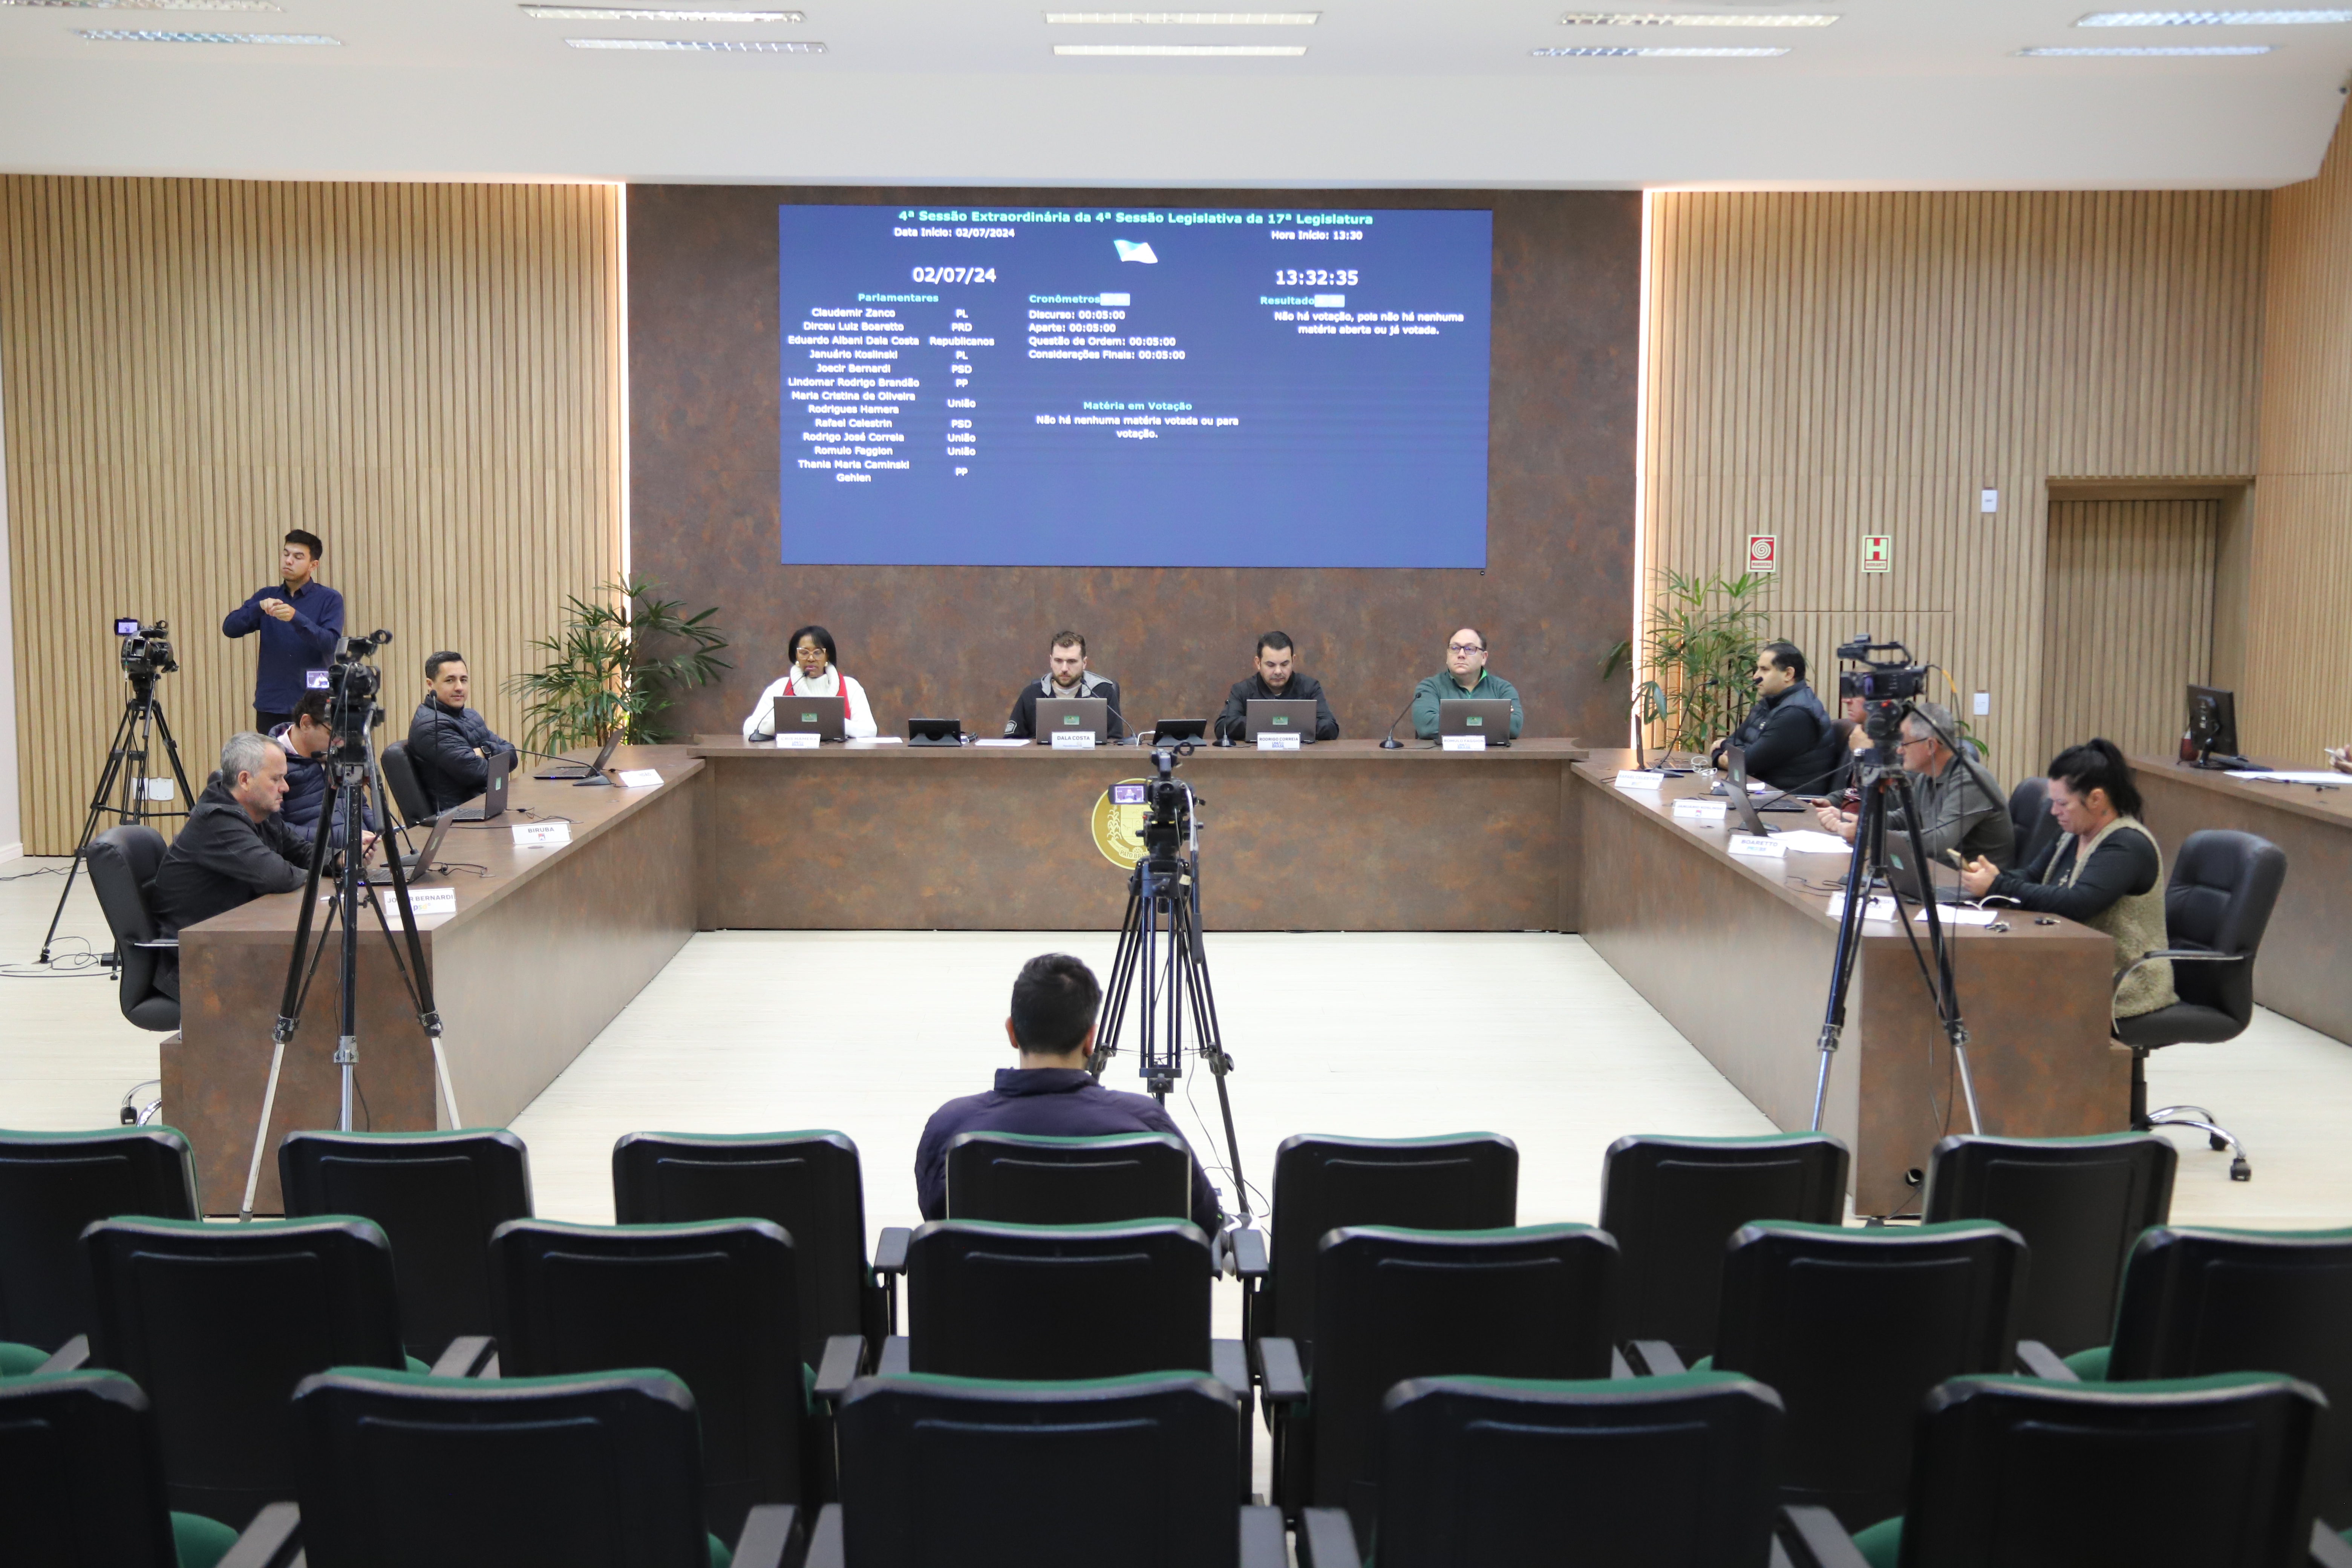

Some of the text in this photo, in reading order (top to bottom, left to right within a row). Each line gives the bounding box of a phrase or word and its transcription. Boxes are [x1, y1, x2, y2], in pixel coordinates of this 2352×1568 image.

[919, 210, 968, 222] Sessão
[970, 211, 1070, 223] Extraordinária
[1074, 211, 1091, 223] da
[1115, 212, 1164, 223] Sessão
[1168, 212, 1242, 226] Legislativa
[1246, 213, 1263, 224] da
[1296, 213, 1373, 227] Legislatura
[894, 227, 1015, 239] Data Início: 02/07/2024
[1271, 230, 1363, 240] Hora Início: 13:30
[912, 267, 997, 285] 02/07/24
[1276, 270, 1358, 286] 13:32:35
[858, 293, 939, 302] Parlamentares
[1029, 294, 1100, 303] Cronômetros
[1260, 296, 1314, 305] Resultado
[811, 308, 896, 317] Claudemir Zanco
[956, 309, 969, 318] PL
[1029, 309, 1125, 320] Discurso: 00:05:00
[1274, 311, 1464, 323] Não há votação, pois não há nenhuma
[803, 321, 904, 331] Dirceu Luiz Boaretto
[951, 322, 972, 332] PRD
[1028, 323, 1116, 334] Aparte: 00:05:00
[1298, 324, 1337, 334] matéria
[1339, 325, 1372, 334] aberta
[1389, 324, 1400, 336] já
[1402, 325, 1439, 335] votada.
[788, 335, 919, 345] Eduardo Albani Dala Costa
[929, 336, 995, 347] Republicanos
[1028, 335, 1176, 347] Questão de Ordem: 00:05:00
[809, 349, 852, 359] Januário
[956, 351, 968, 360] PL
[1028, 349, 1185, 361] Considerações Finais: 00:05:00
[816, 363, 891, 373] Joecir Bernardi
[951, 364, 972, 374] PSD
[788, 377, 920, 389] Lindomar Rodrigo Brandão
[956, 378, 968, 387] PP
[791, 391, 916, 401] Maria Cristina de Oliveira
[947, 398, 976, 408] União
[1083, 401, 1125, 410] Matéria
[1148, 402, 1192, 412] Votação
[808, 404, 899, 415] Rodrigues Hamera
[815, 418, 892, 428] Rafael Celestrin
[951, 419, 972, 429] PSD
[1036, 415, 1056, 424] Não
[1058, 415, 1071, 424] há
[1074, 415, 1120, 425] nenhuma
[1123, 415, 1162, 425] matéria
[1164, 416, 1198, 425] votada
[1216, 418, 1239, 427] para
[803, 432, 904, 443] Rodrigo José Correia
[947, 433, 976, 443] União
[1116, 429, 1158, 440] votação.
[814, 446, 893, 457] Romulo Faggion
[947, 446, 976, 456] União
[798, 459, 910, 469] Thania Maria Caminski
[955, 467, 968, 476] PP
[836, 473, 871, 482] Gehlen
[1866, 539, 1887, 559] H
